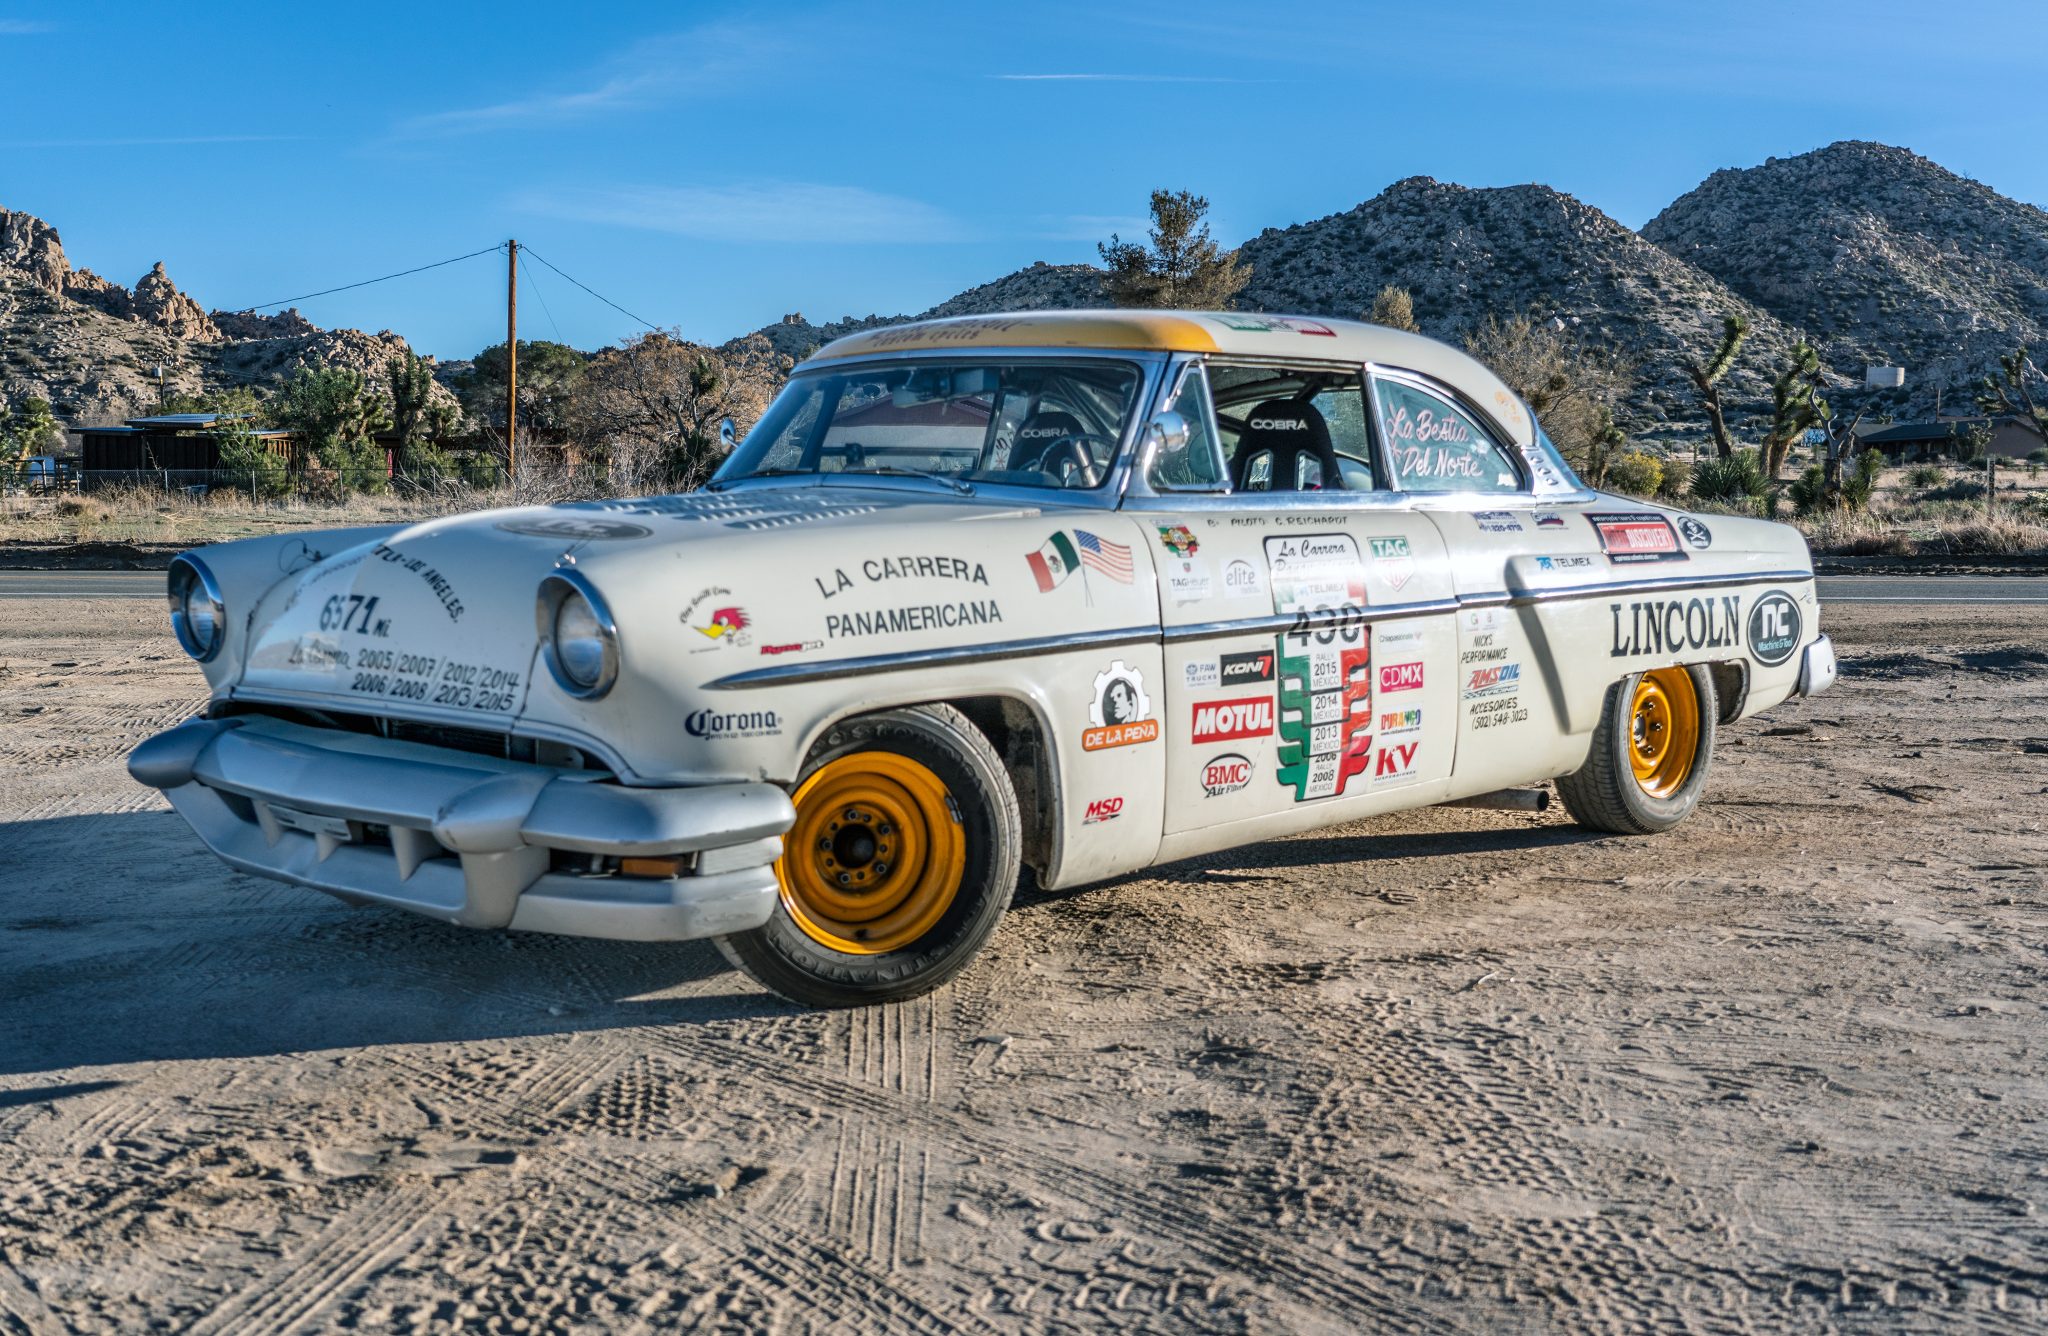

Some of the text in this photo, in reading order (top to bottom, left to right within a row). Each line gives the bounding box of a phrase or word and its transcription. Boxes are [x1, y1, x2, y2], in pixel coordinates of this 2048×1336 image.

[1250, 417, 1309, 431] COBRA
[1386, 402, 1470, 441] La Bestia
[1021, 426, 1070, 439] COBRA
[1401, 446, 1484, 478] Del Norte
[1278, 540, 1346, 558] La Carrera
[1372, 540, 1408, 558] TAG
[1554, 557, 1591, 568] TELMEX
[815, 556, 989, 599] LA CARRERA
[1226, 567, 1255, 586] elite
[1309, 583, 1345, 593] TELMEX
[826, 599, 1003, 638] PANAMERICANA
[1287, 602, 1362, 647] 430
[1610, 595, 1739, 658] LINCOLN
[1460, 647, 1508, 664] PERFORMANCE
[1223, 660, 1264, 676] KONI
[1314, 662, 1337, 676] 2015
[1381, 664, 1422, 687] CDMX
[1467, 664, 1519, 690] AMSOIL
[1186, 674, 1216, 682] TRUCKS
[1313, 676, 1339, 687] MEXICO
[1315, 694, 1337, 709] 2014
[1470, 697, 1518, 715] ACCESORIES
[1193, 702, 1272, 735] MOTUL
[1313, 709, 1340, 720] MEXICO
[684, 708, 777, 740] Corona
[1315, 726, 1337, 740] 2013
[1085, 724, 1156, 747] DE LA PEÑA
[1313, 740, 1339, 751] MEXICO
[1375, 742, 1418, 776] KV
[1205, 763, 1248, 786] BMC
[1312, 770, 1335, 783] 2008
[1204, 786, 1225, 799] Air
[1084, 797, 1123, 818] MSD
